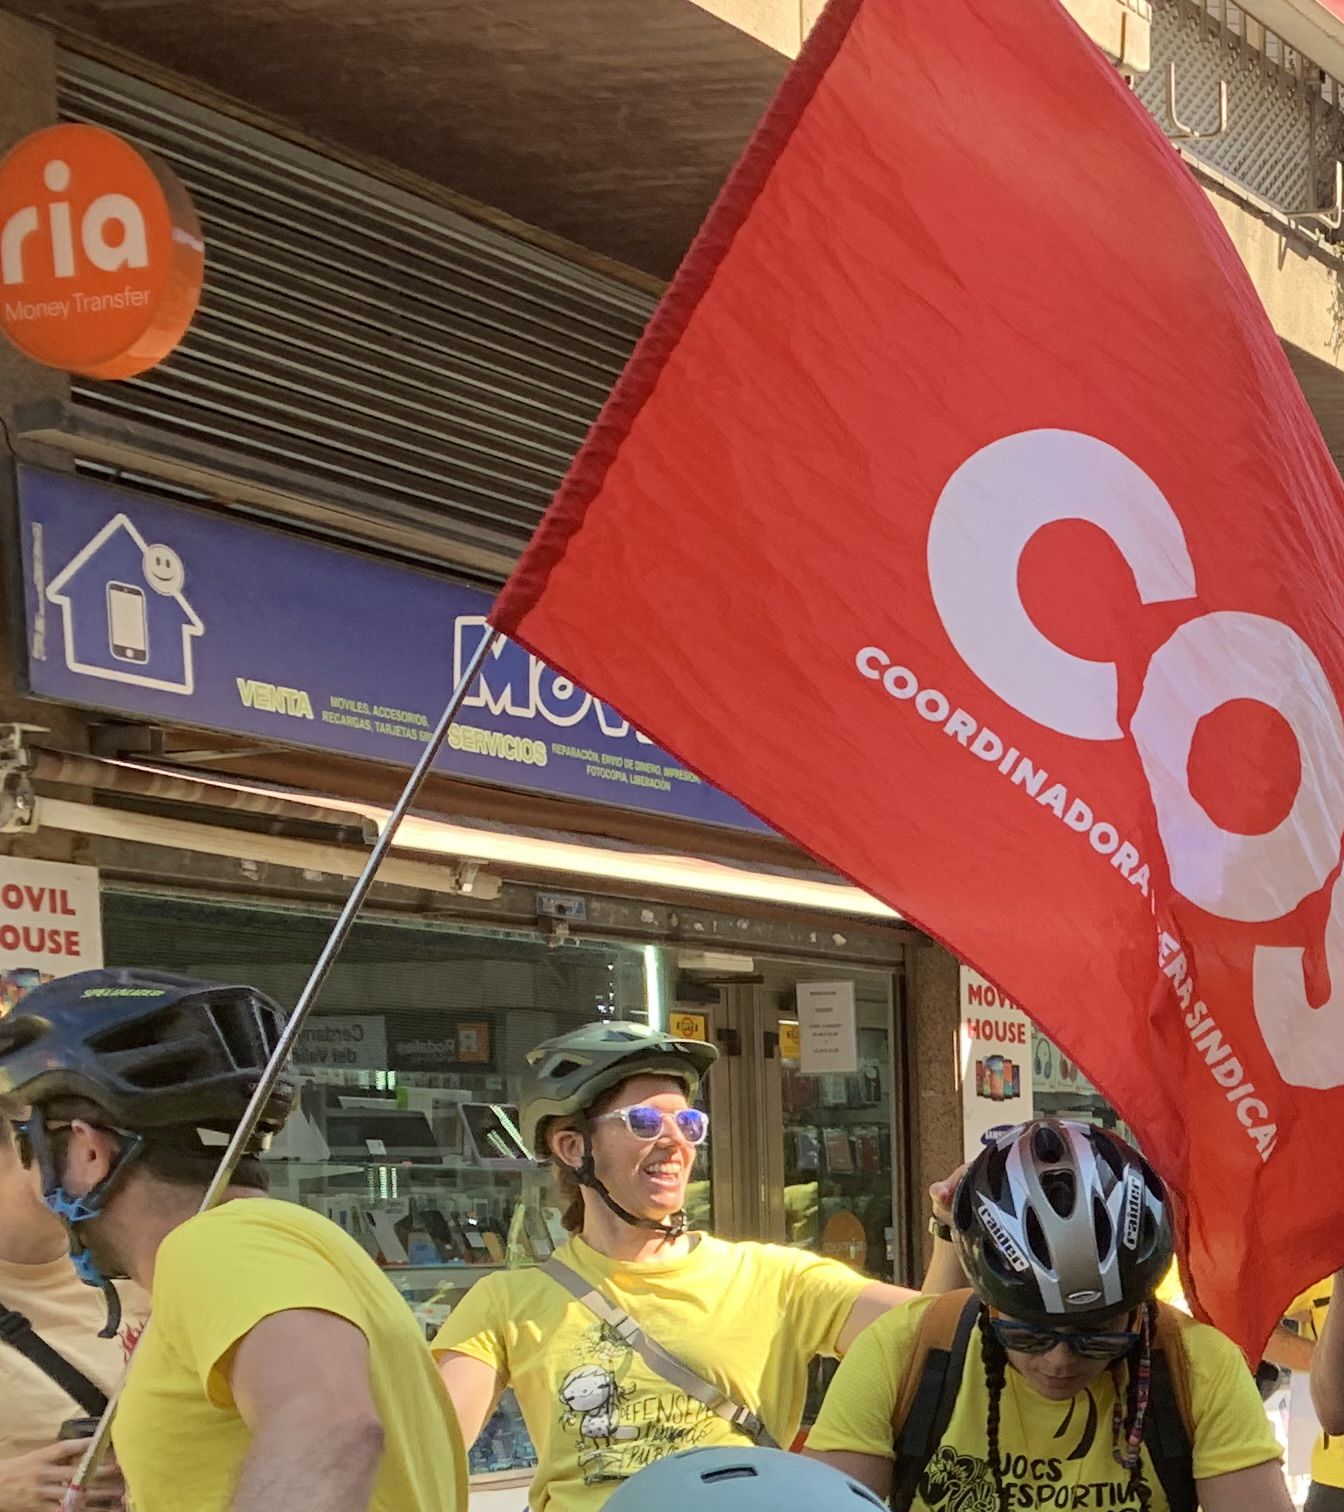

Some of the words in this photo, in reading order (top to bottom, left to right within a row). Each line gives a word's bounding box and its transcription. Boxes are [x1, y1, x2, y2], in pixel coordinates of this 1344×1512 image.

[1, 159, 149, 285] ria
[3, 299, 70, 322] Money
[71, 285, 150, 315] Transfer
[236, 677, 315, 721] VENTA
[447, 722, 548, 767] SERVICIOS
[2, 883, 77, 916] OVIL
[855, 645, 1149, 898] COORDINADORA
[1185, 1000, 1279, 1163] SINDICA
[0, 924, 81, 957] OUSE
[967, 1017, 1027, 1045] HOUSE
[1126, 1177, 1142, 1246] raider
[980, 1206, 1026, 1270] raider
[999, 1452, 1063, 1483] JOCS
[1002, 1481, 1145, 1511] ESPORTIU
